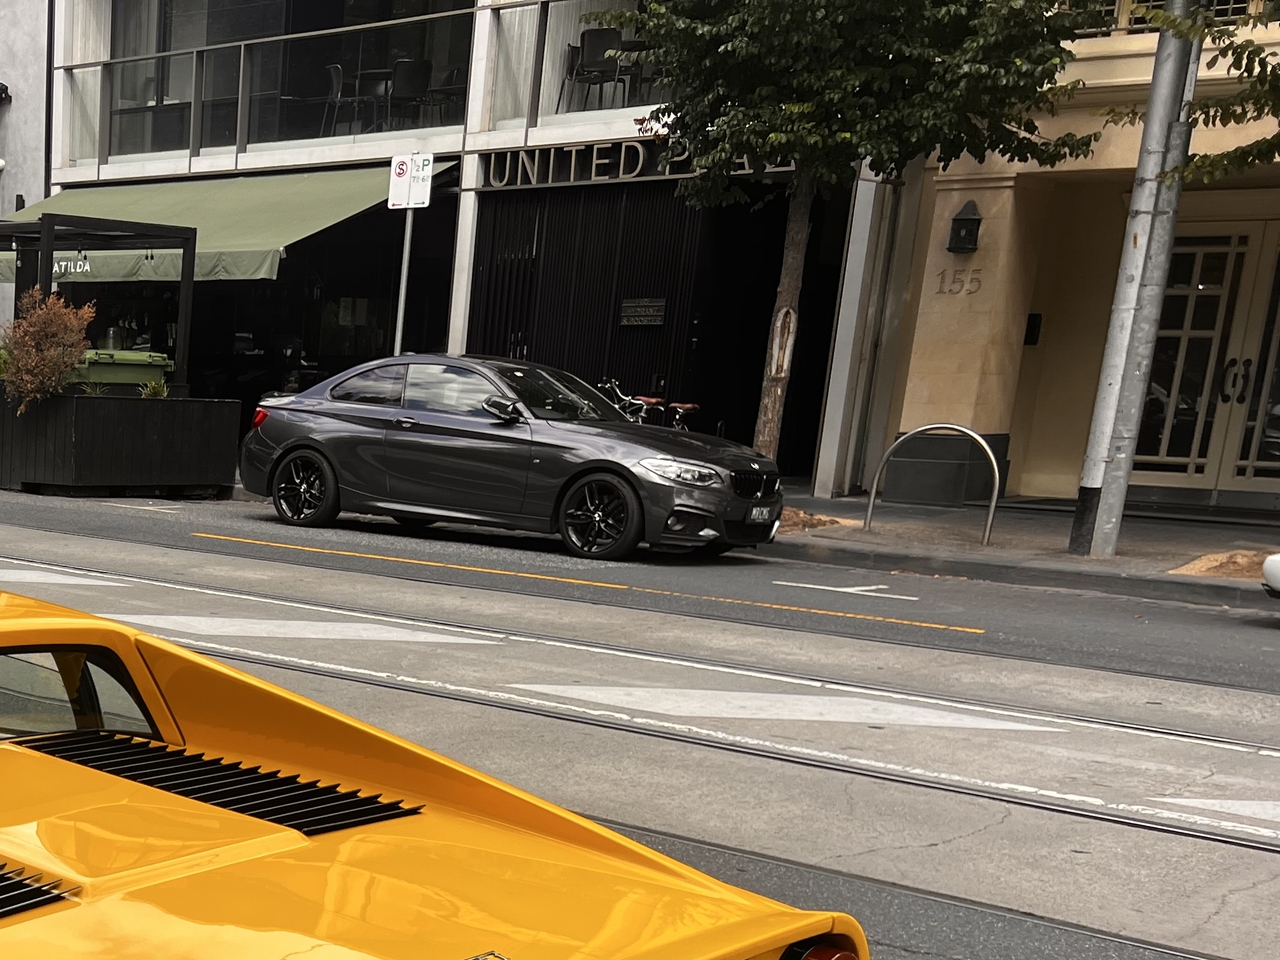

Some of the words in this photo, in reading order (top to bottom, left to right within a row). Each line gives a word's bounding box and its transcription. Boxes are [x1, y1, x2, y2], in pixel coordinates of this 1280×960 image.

[488, 140, 645, 188] UNITED
[52, 261, 91, 274] ATILDA
[935, 268, 983, 295] 155
